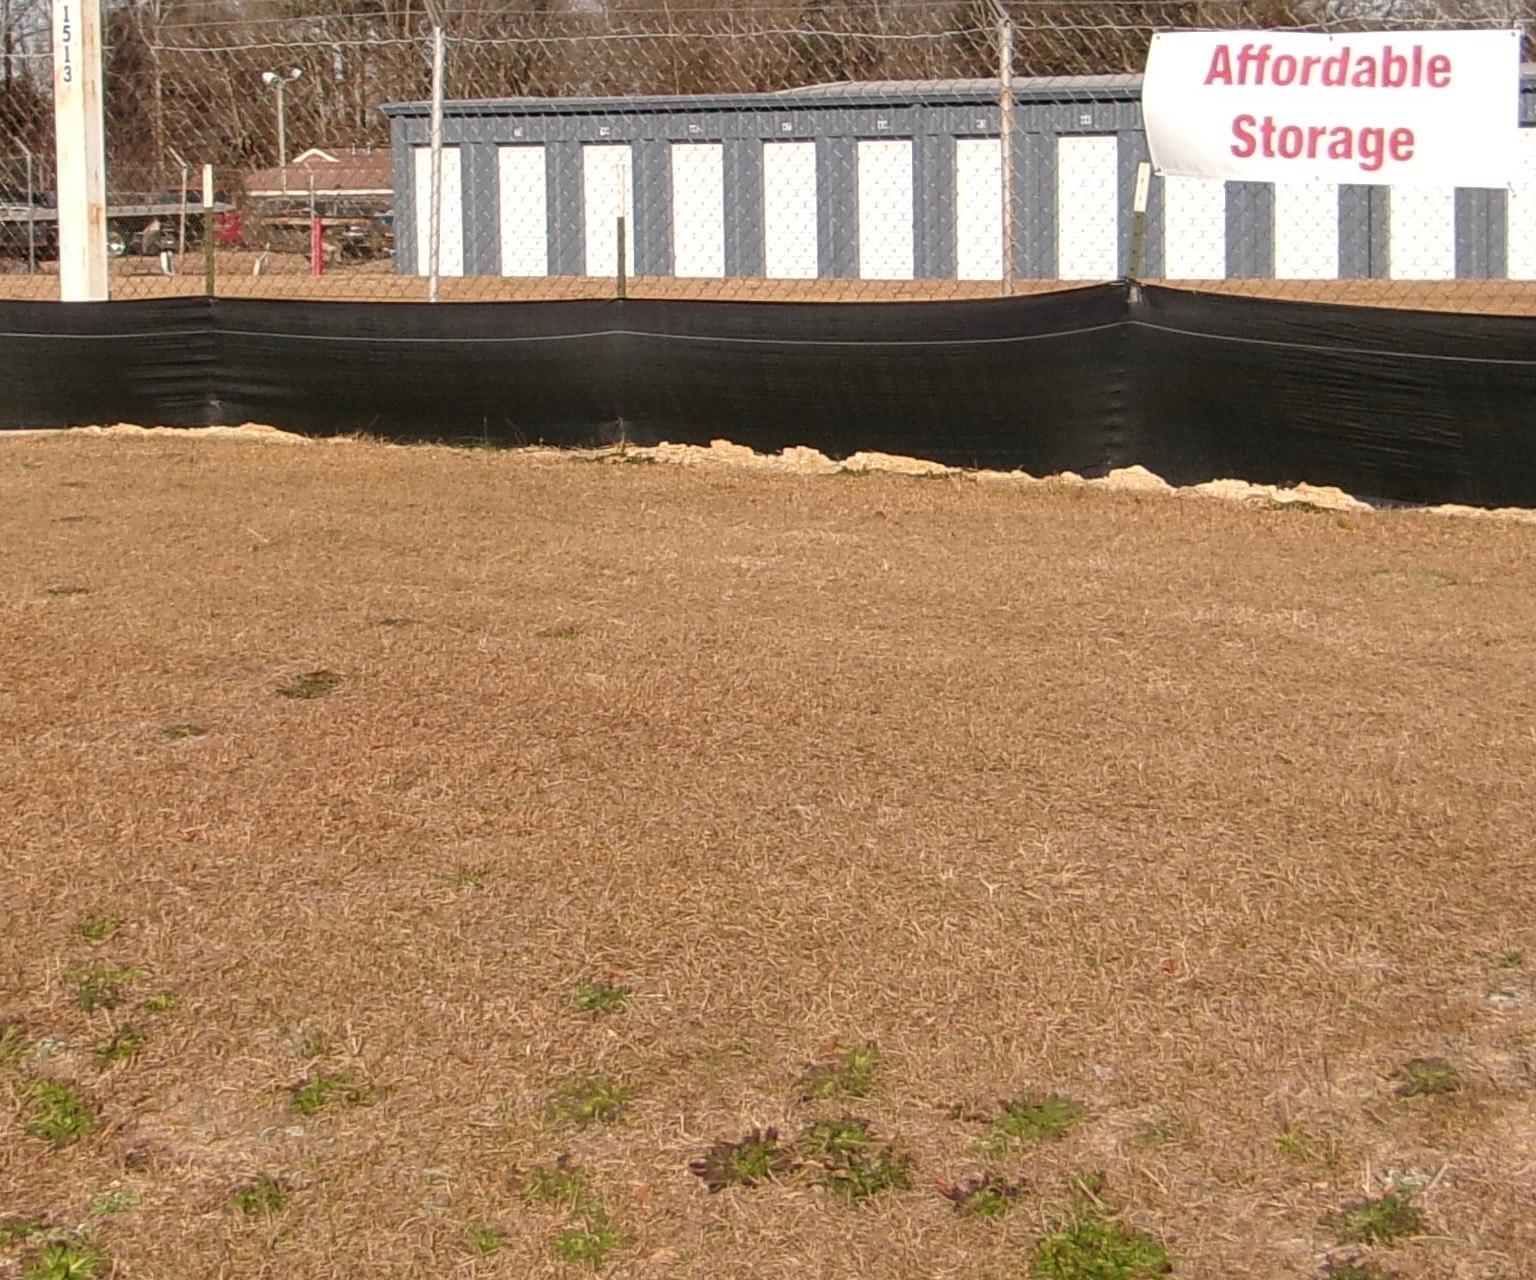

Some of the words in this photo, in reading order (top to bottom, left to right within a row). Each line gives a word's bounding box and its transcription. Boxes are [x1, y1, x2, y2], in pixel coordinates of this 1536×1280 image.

[62, 5, 72, 83] 1513
[1204, 43, 1452, 88] Affordable
[1230, 114, 1415, 172] Storage
